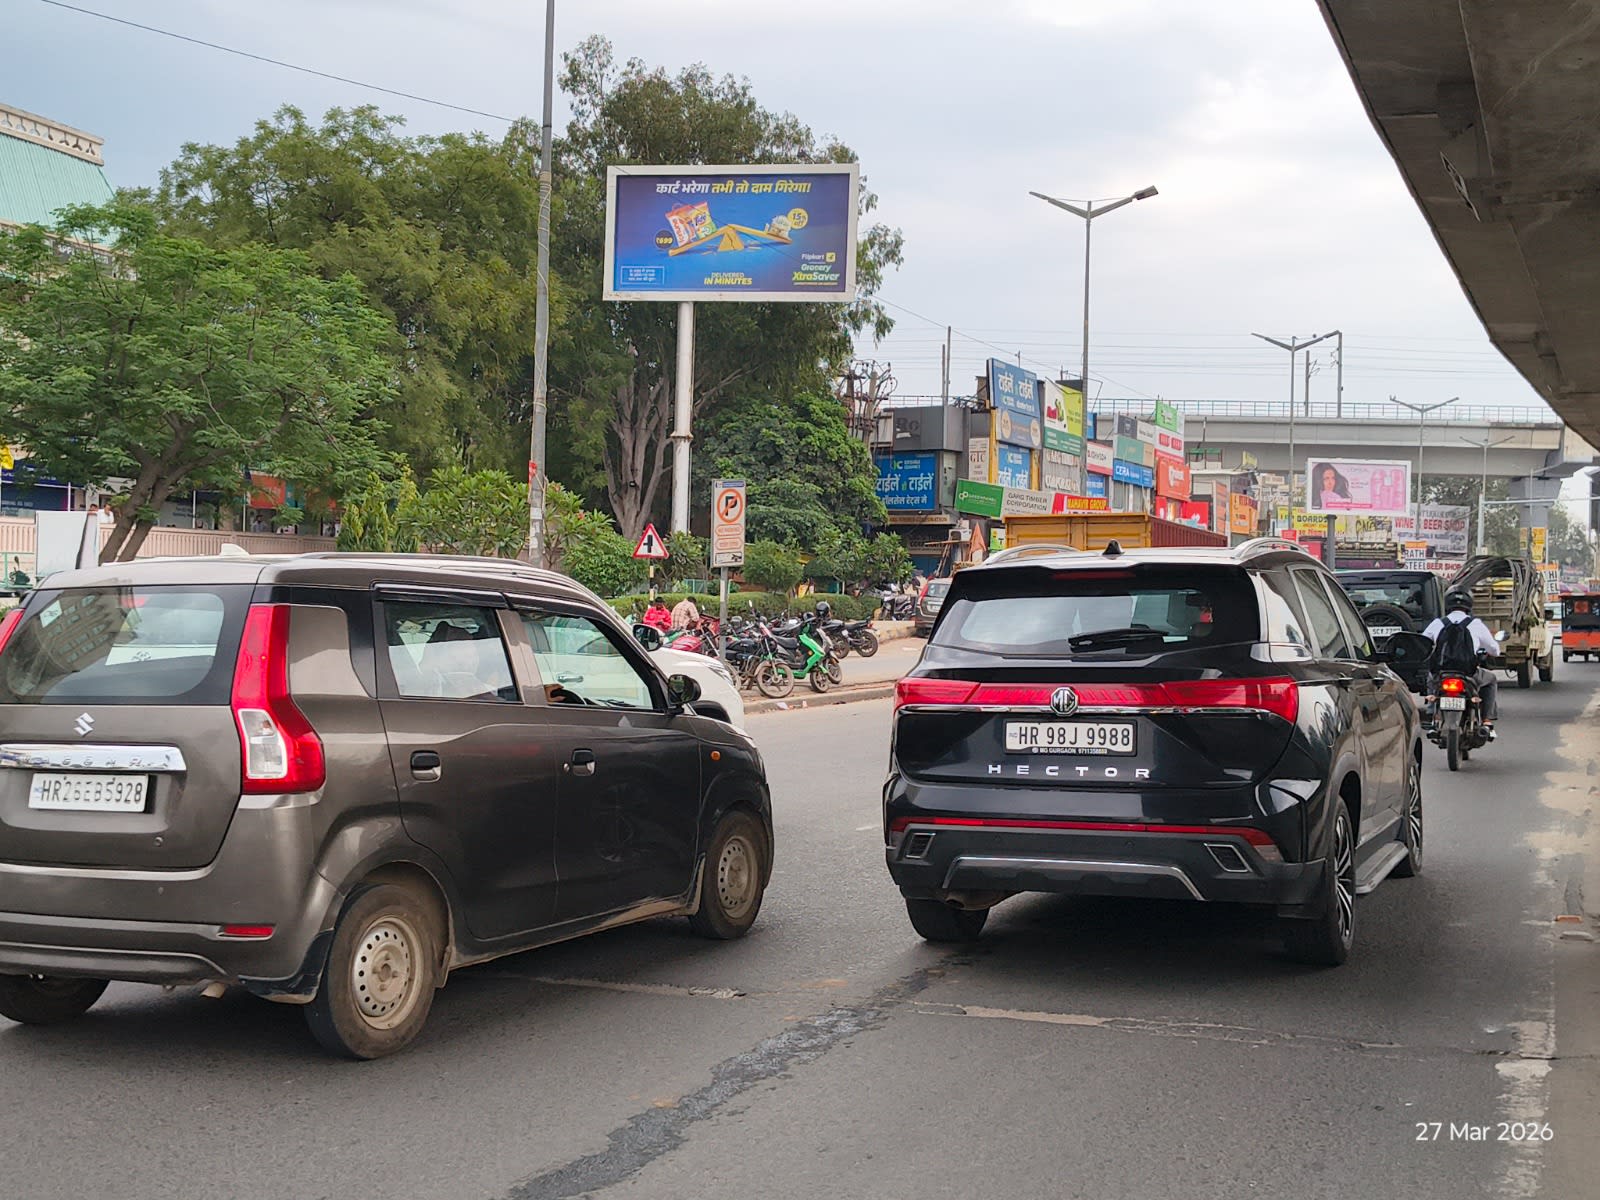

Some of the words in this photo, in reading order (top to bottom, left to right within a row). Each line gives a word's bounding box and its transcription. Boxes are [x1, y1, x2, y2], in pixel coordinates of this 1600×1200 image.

[656, 180, 680, 193] कार्ट
[682, 180, 710, 193] भरेगा
[711, 180, 734, 193] तभी
[736, 180, 750, 193] तो
[752, 183, 773, 193] दाम
[801, 253, 825, 261] Flipkart
[801, 263, 832, 272] Grocery
[1115, 465, 1130, 476] CERA
[1007, 500, 1048, 511] CORPORATION
[1395, 518, 1414, 529] WINE
[1423, 519, 1442, 530] BEER
[1444, 520, 1465, 531] SHOP
[1427, 562, 1443, 570] BEER
[1018, 726, 1039, 745] HR
[1046, 727, 1077, 746] 98J
[1087, 727, 1130, 746] 9988
[988, 765, 1150, 778] HECTOR
